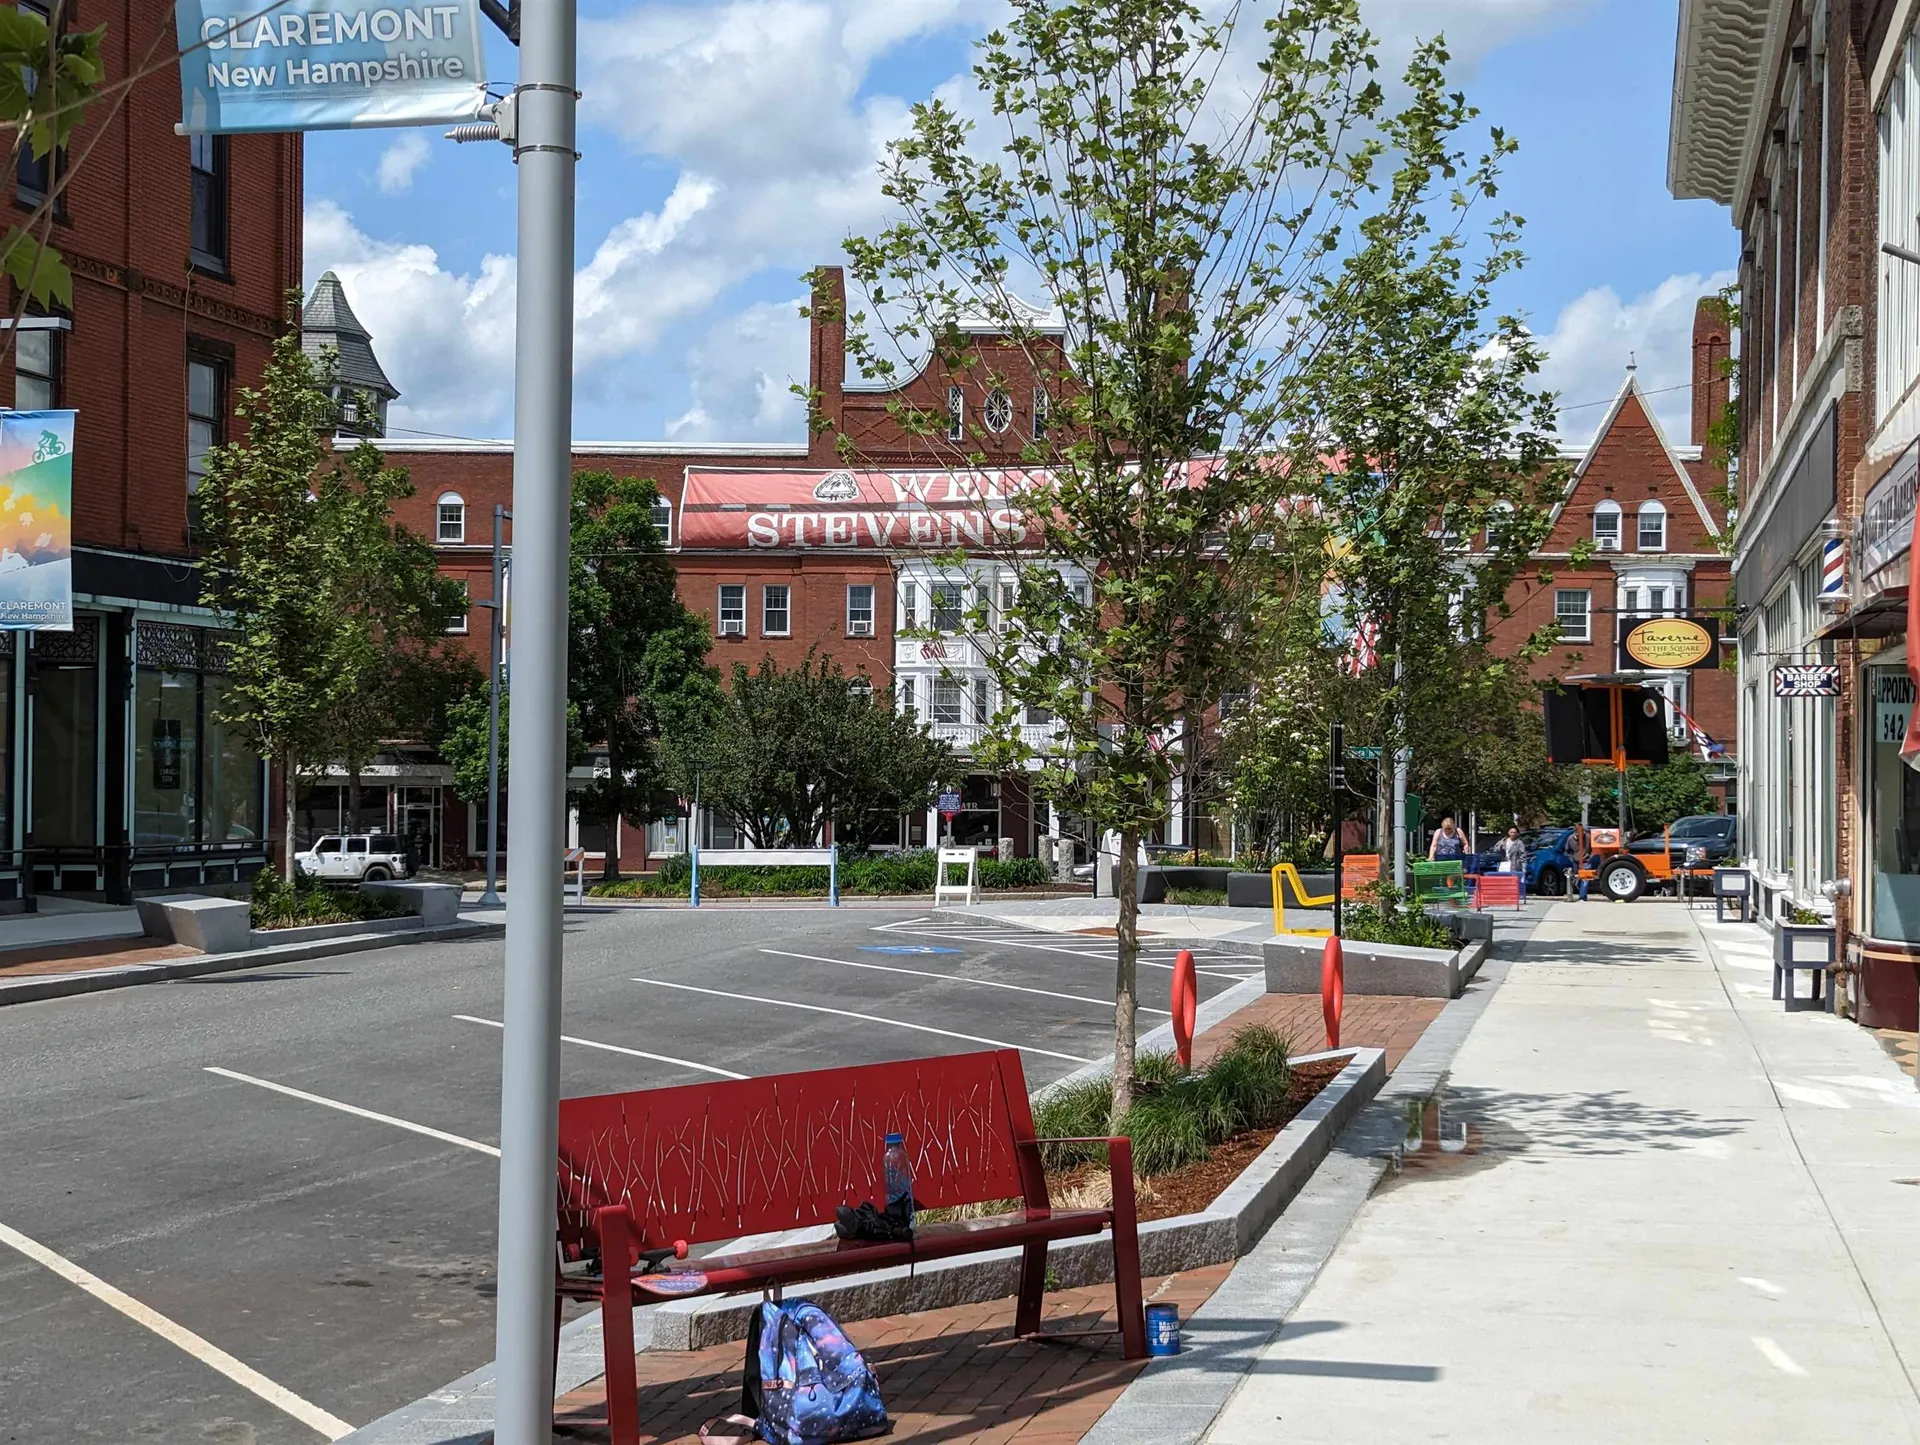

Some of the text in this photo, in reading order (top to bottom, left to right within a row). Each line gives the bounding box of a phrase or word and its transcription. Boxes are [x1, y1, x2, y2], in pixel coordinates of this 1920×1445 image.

[201, 6, 459, 50] CLAREMONT
[207, 51, 464, 88] New Hampshire
[747, 508, 1027, 549] STEVENS
[0, 601, 66, 610] CLAREMONT
[0, 612, 67, 621] New Hampshire
[1634, 629, 1704, 644] Taverne
[1786, 673, 1828, 682] BARBER
[1883, 714, 1904, 741] 542
